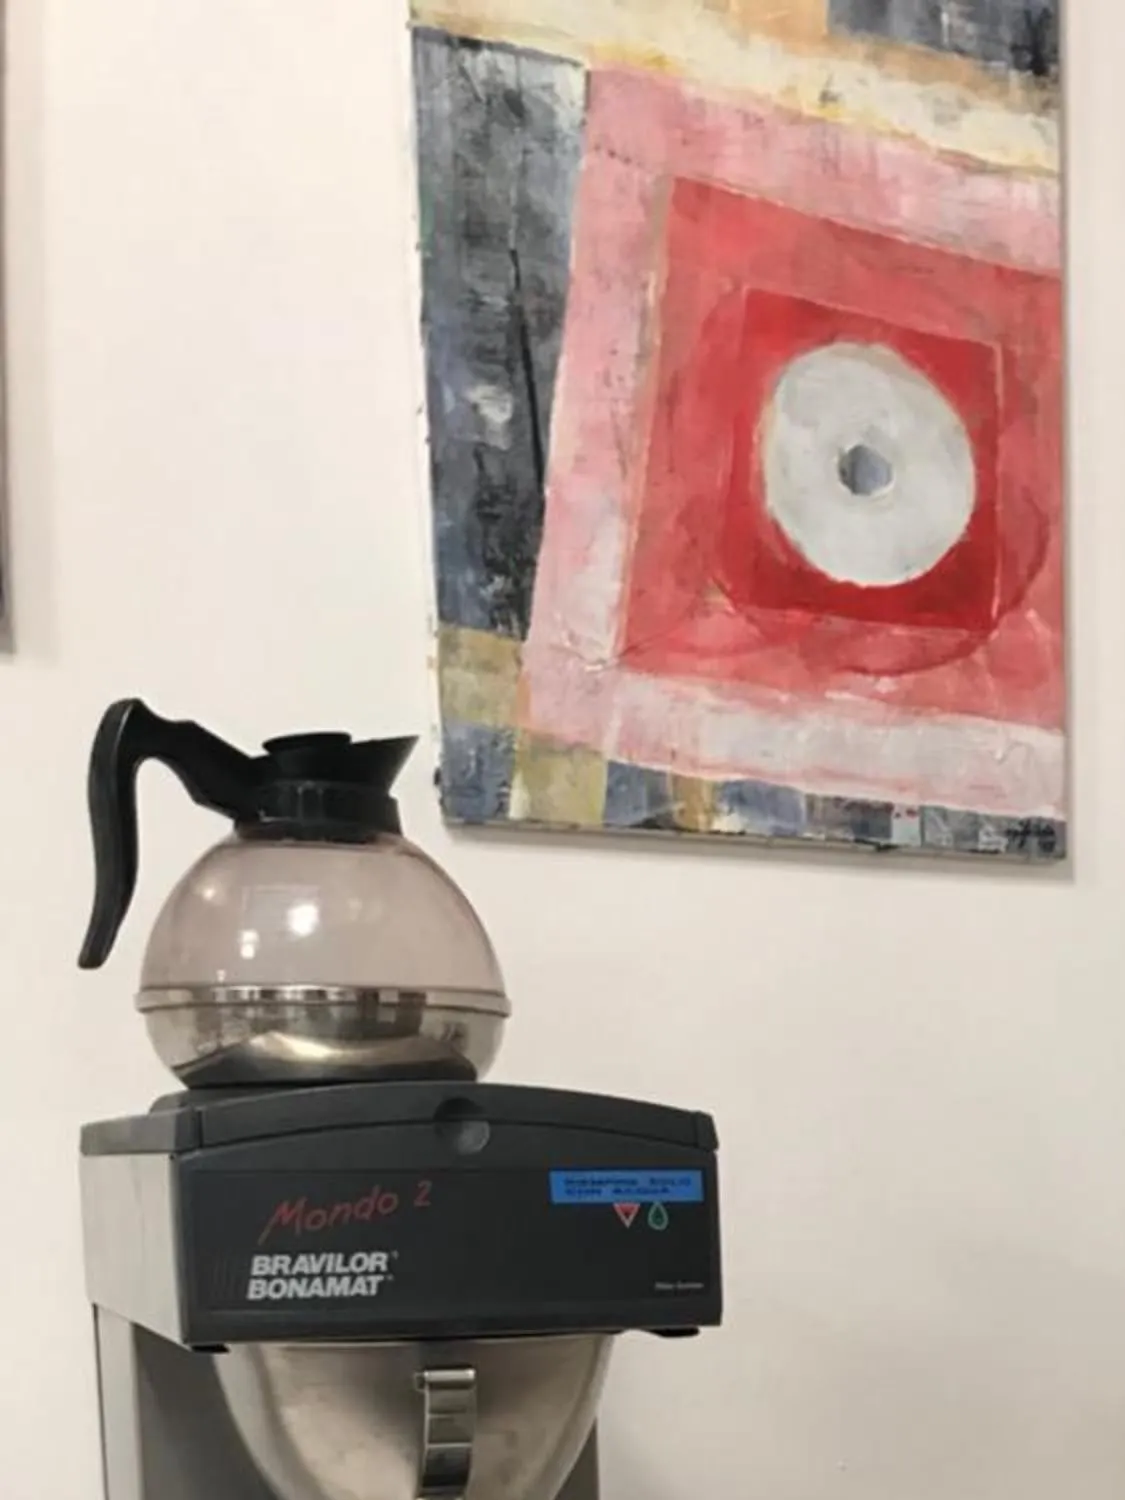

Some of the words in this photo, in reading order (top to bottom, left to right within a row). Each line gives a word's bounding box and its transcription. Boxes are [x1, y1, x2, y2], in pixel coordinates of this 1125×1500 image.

[257, 1184, 399, 1246] Mondo
[414, 1180, 432, 1207] 2
[251, 1251, 390, 1277] BRAVILOR
[247, 1275, 385, 1300] BONAMAT
